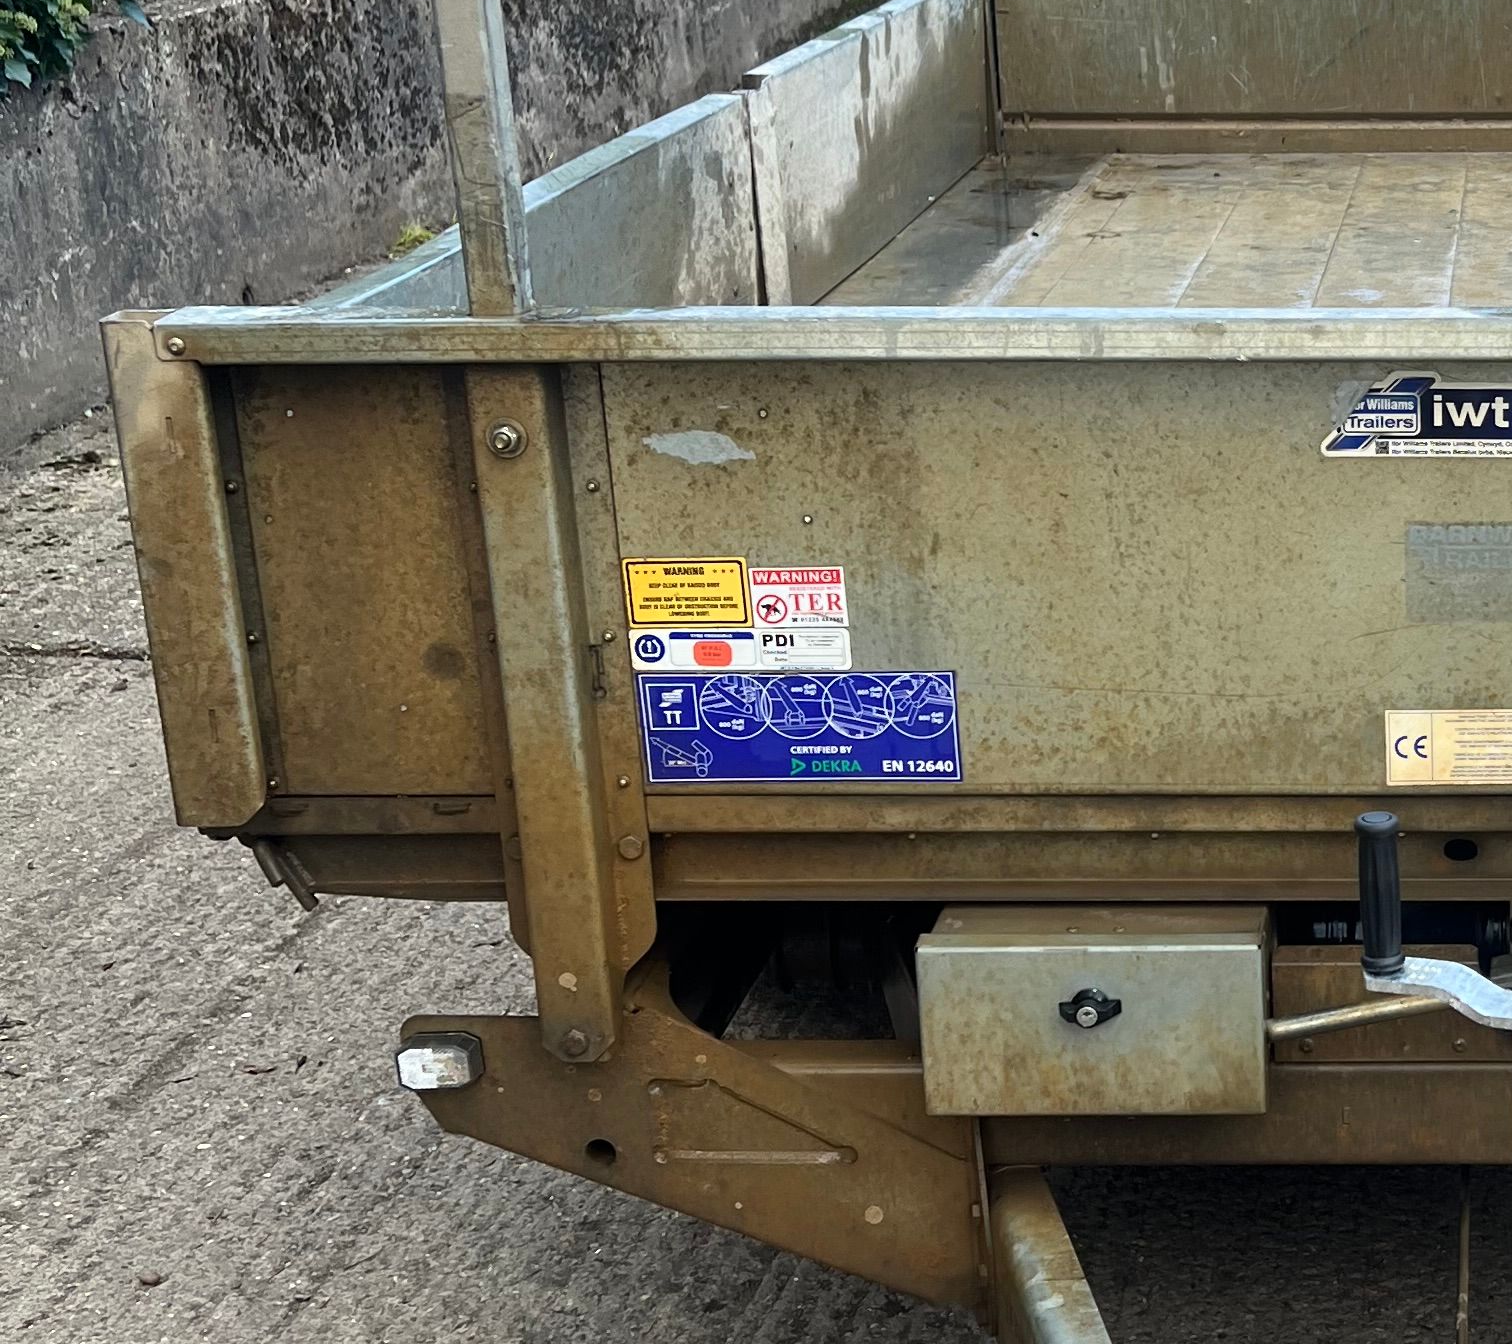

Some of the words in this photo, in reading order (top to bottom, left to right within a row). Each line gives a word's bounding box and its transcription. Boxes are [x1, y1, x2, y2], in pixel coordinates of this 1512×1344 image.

[1366, 398, 1415, 411] Williams
[1347, 415, 1414, 429] Trailers
[663, 566, 705, 576] WARNING
[753, 570, 837, 583] WARNING!
[788, 592, 843, 611] TER
[762, 634, 795, 647] PDI
[663, 710, 683, 725] TT
[789, 746, 839, 754] CERTIFIED
[839, 746, 853, 754] BY
[1394, 735, 1428, 759] CE
[811, 759, 863, 773] DEKRA
[882, 759, 904, 773] EN
[907, 759, 954, 773] 12640
